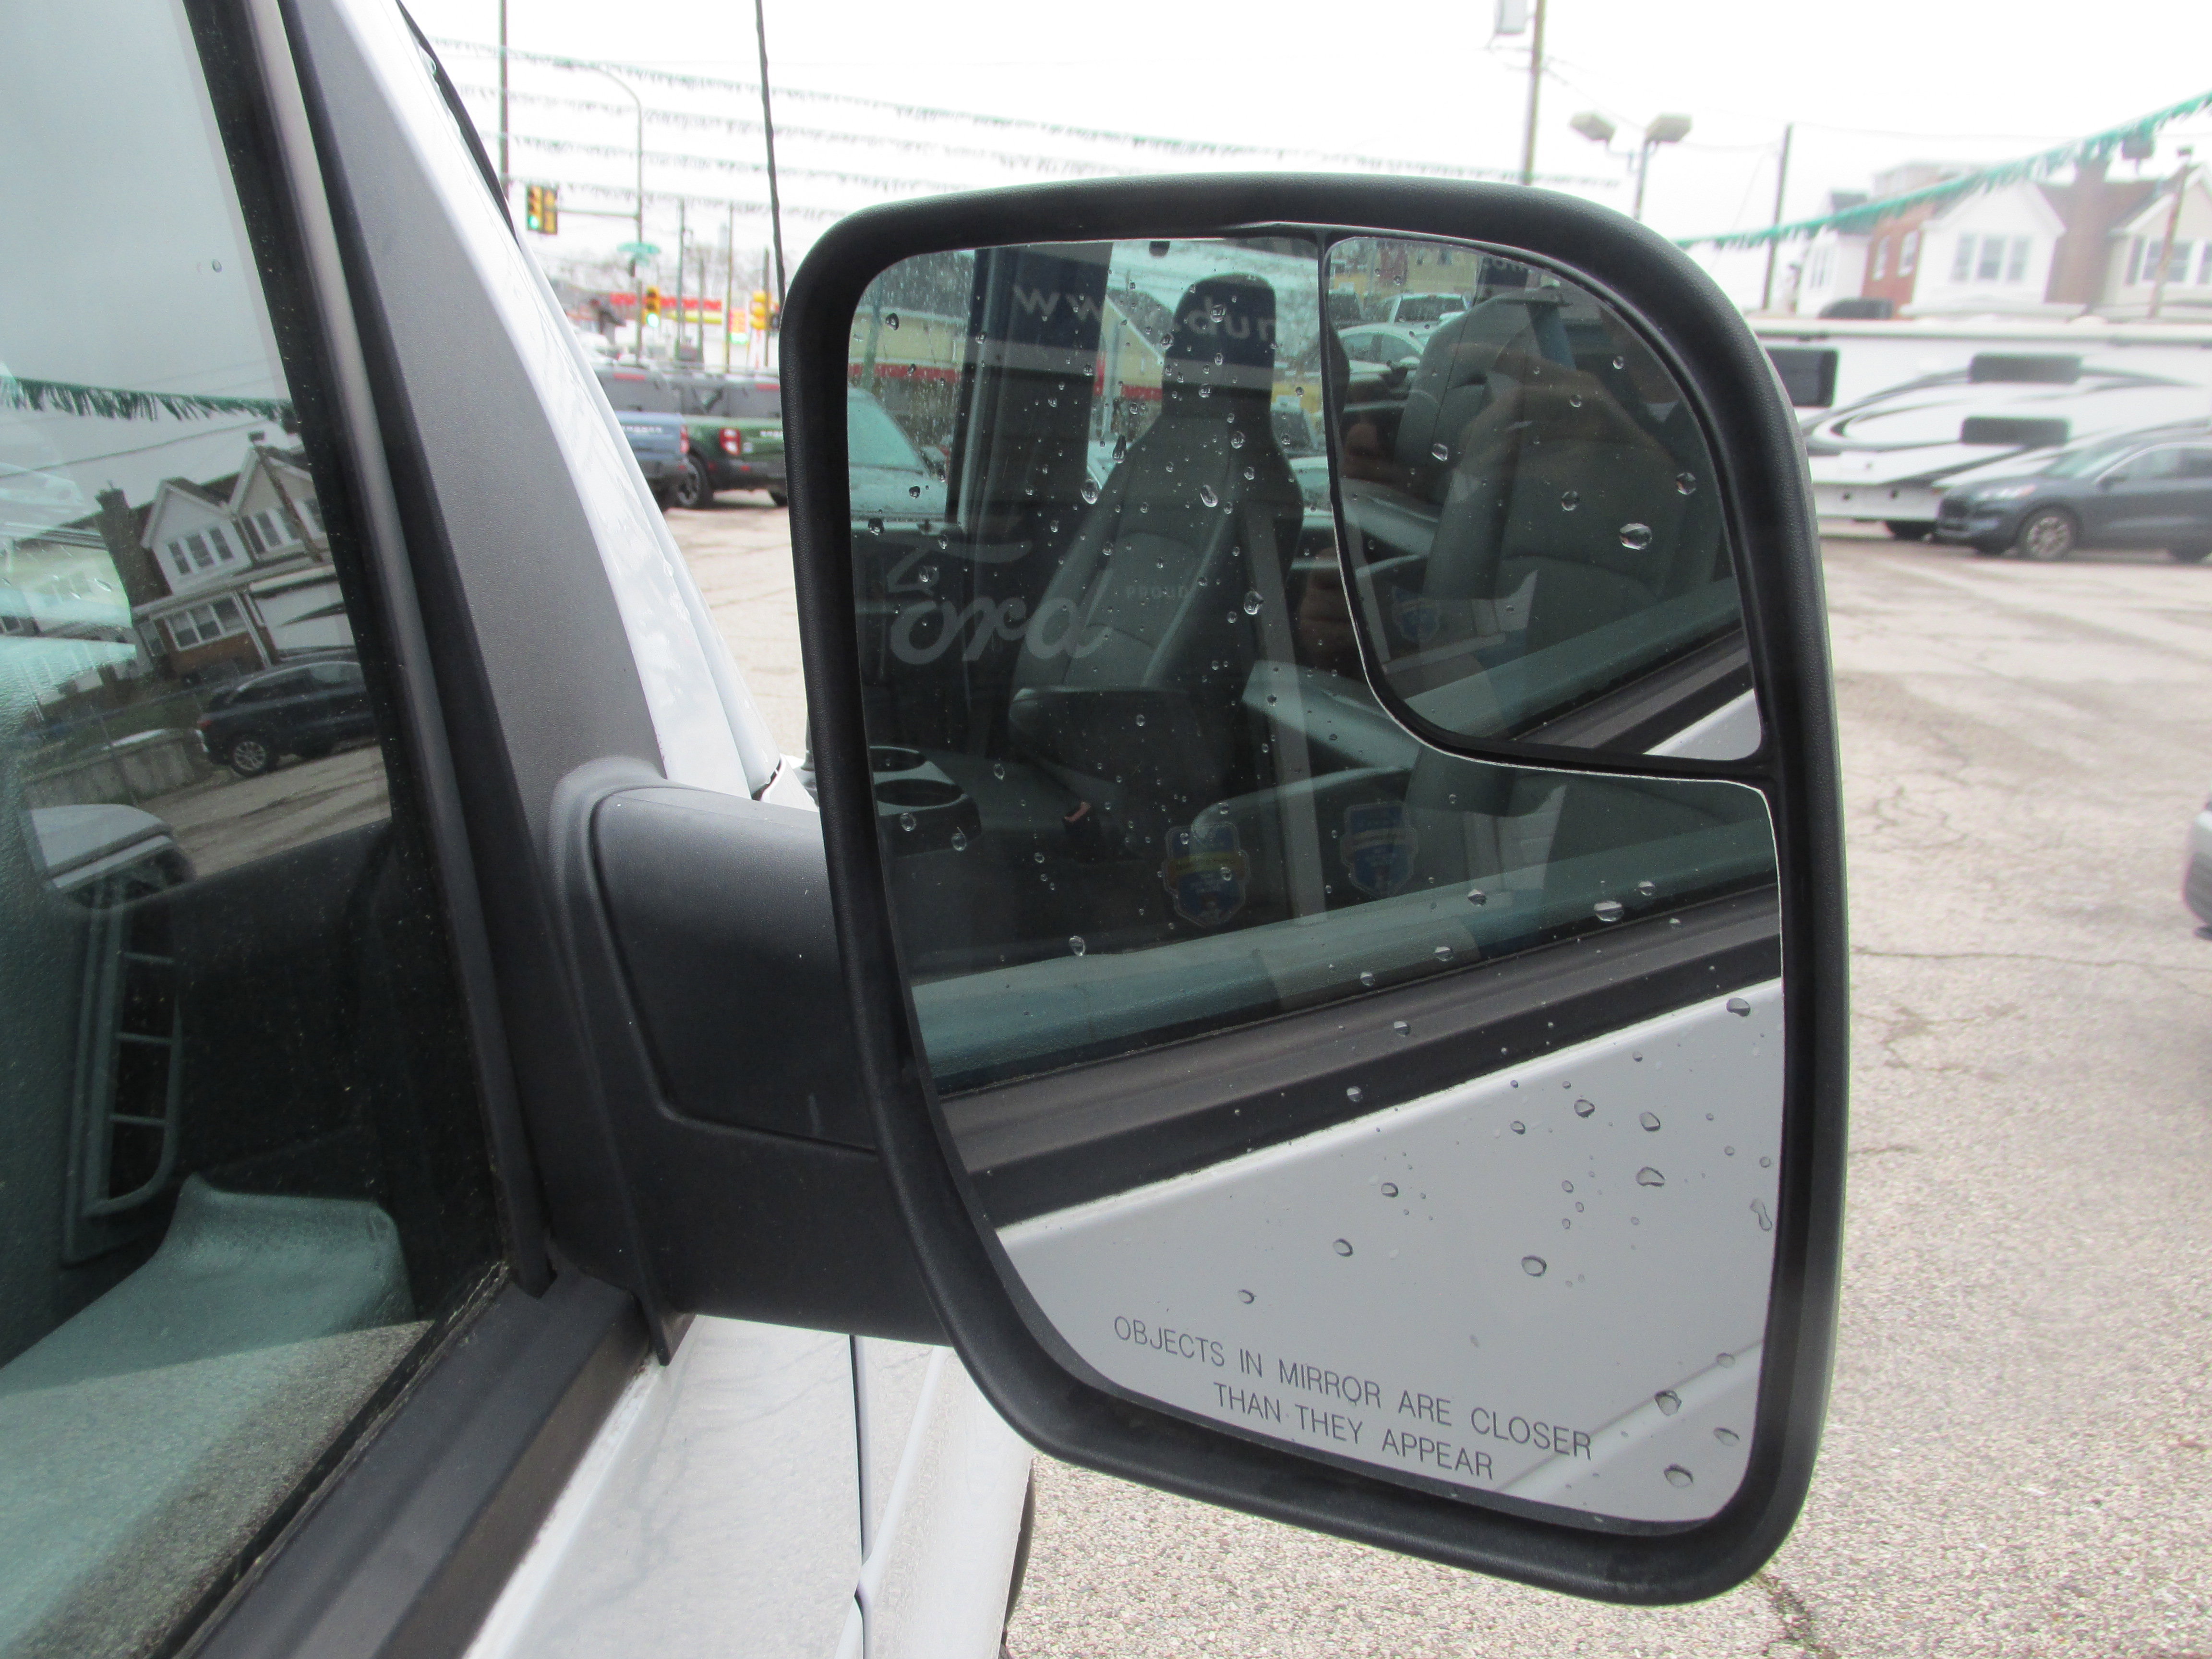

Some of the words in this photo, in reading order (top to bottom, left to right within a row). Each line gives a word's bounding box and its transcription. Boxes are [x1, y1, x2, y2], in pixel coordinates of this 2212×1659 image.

[1114, 1315, 1225, 1367] OBJECTS
[1239, 1348, 1262, 1378] IN
[1278, 1358, 1381, 1408] MIRROR
[1398, 1389, 1452, 1427] ARE
[1470, 1407, 1592, 1461] CLOSER
[1213, 1382, 1281, 1423] THAN
[1294, 1403, 1363, 1444] THEY
[1381, 1428, 1493, 1481] APPEAR
